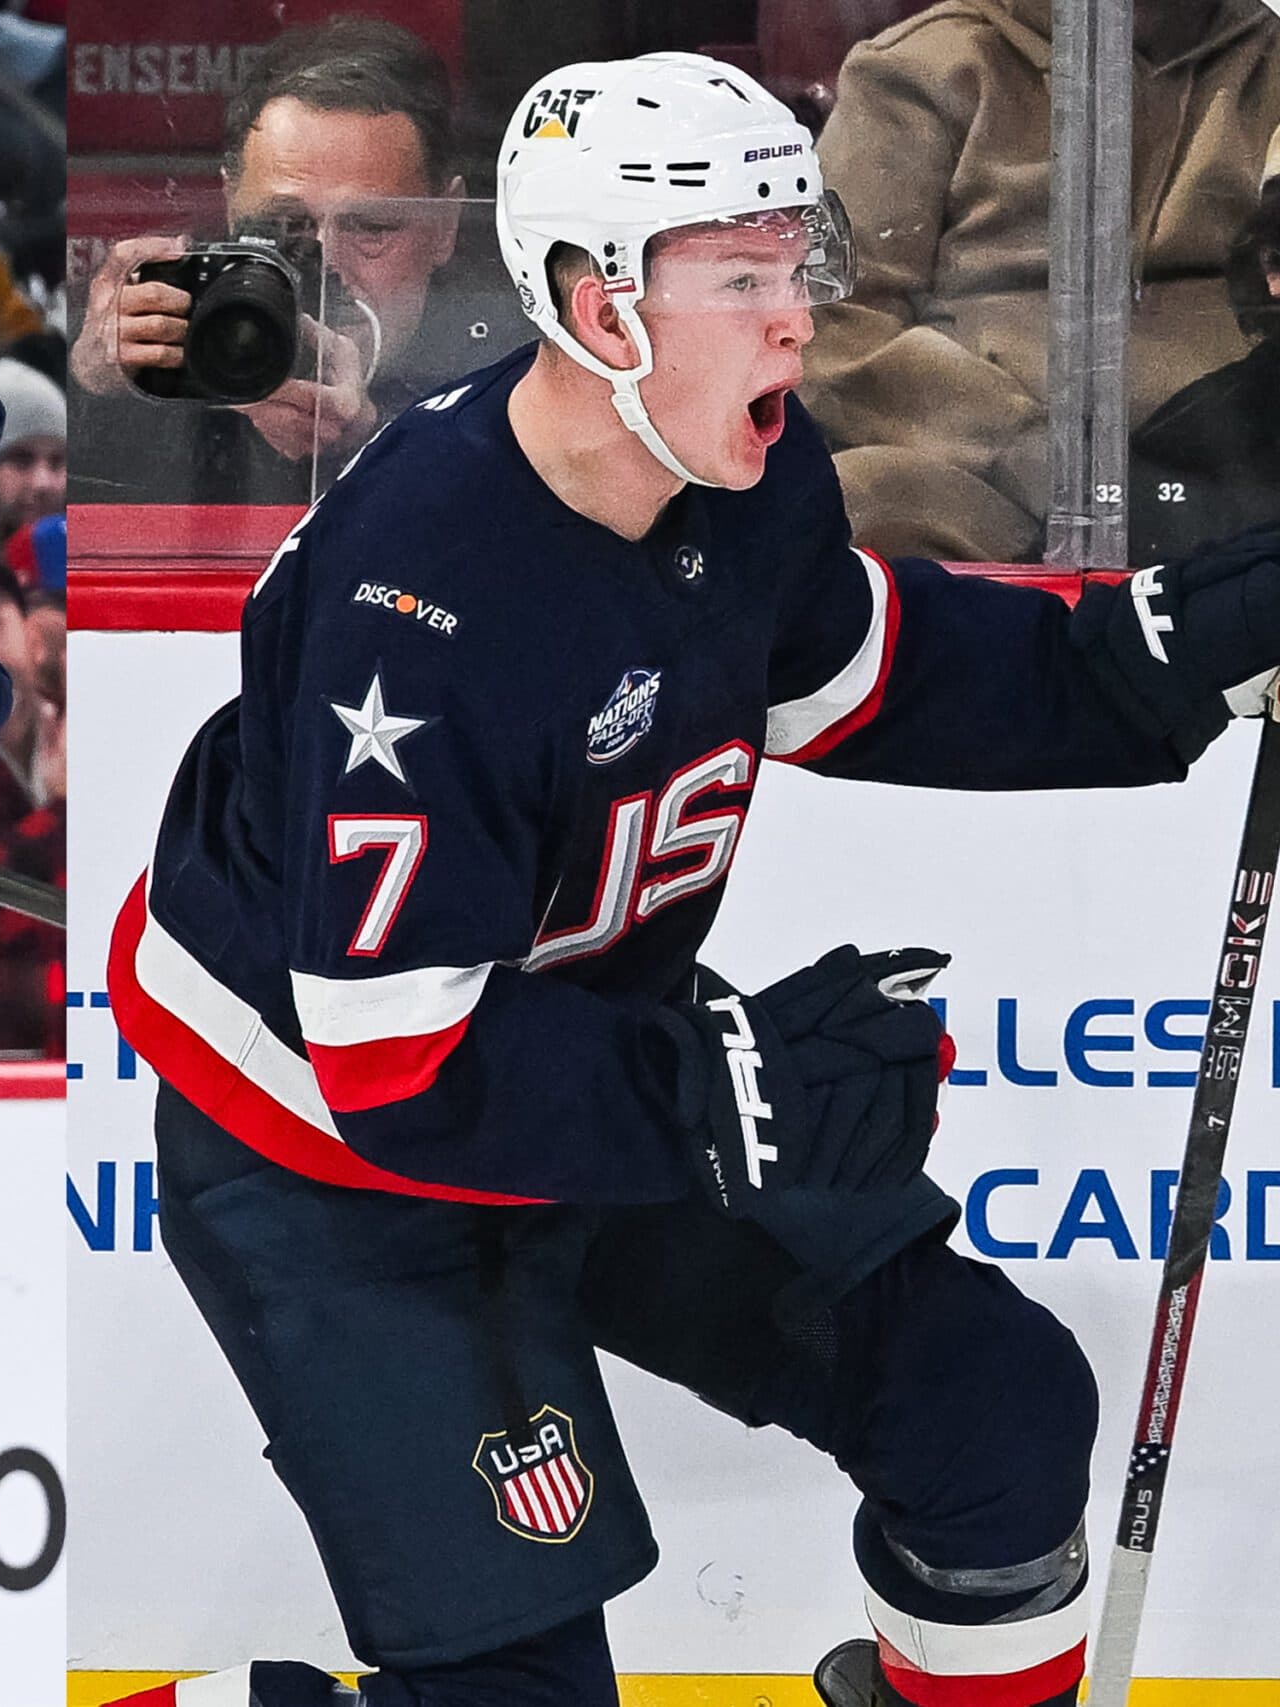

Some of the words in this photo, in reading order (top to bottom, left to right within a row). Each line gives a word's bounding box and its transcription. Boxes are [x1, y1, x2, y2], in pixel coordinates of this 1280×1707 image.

[523, 89, 597, 139] CAT
[1095, 484, 1123, 503] 32
[1158, 482, 1187, 502] 32
[353, 583, 458, 635] DISCOVER
[587, 671, 662, 736] NATIONS
[328, 814, 428, 958] 7
